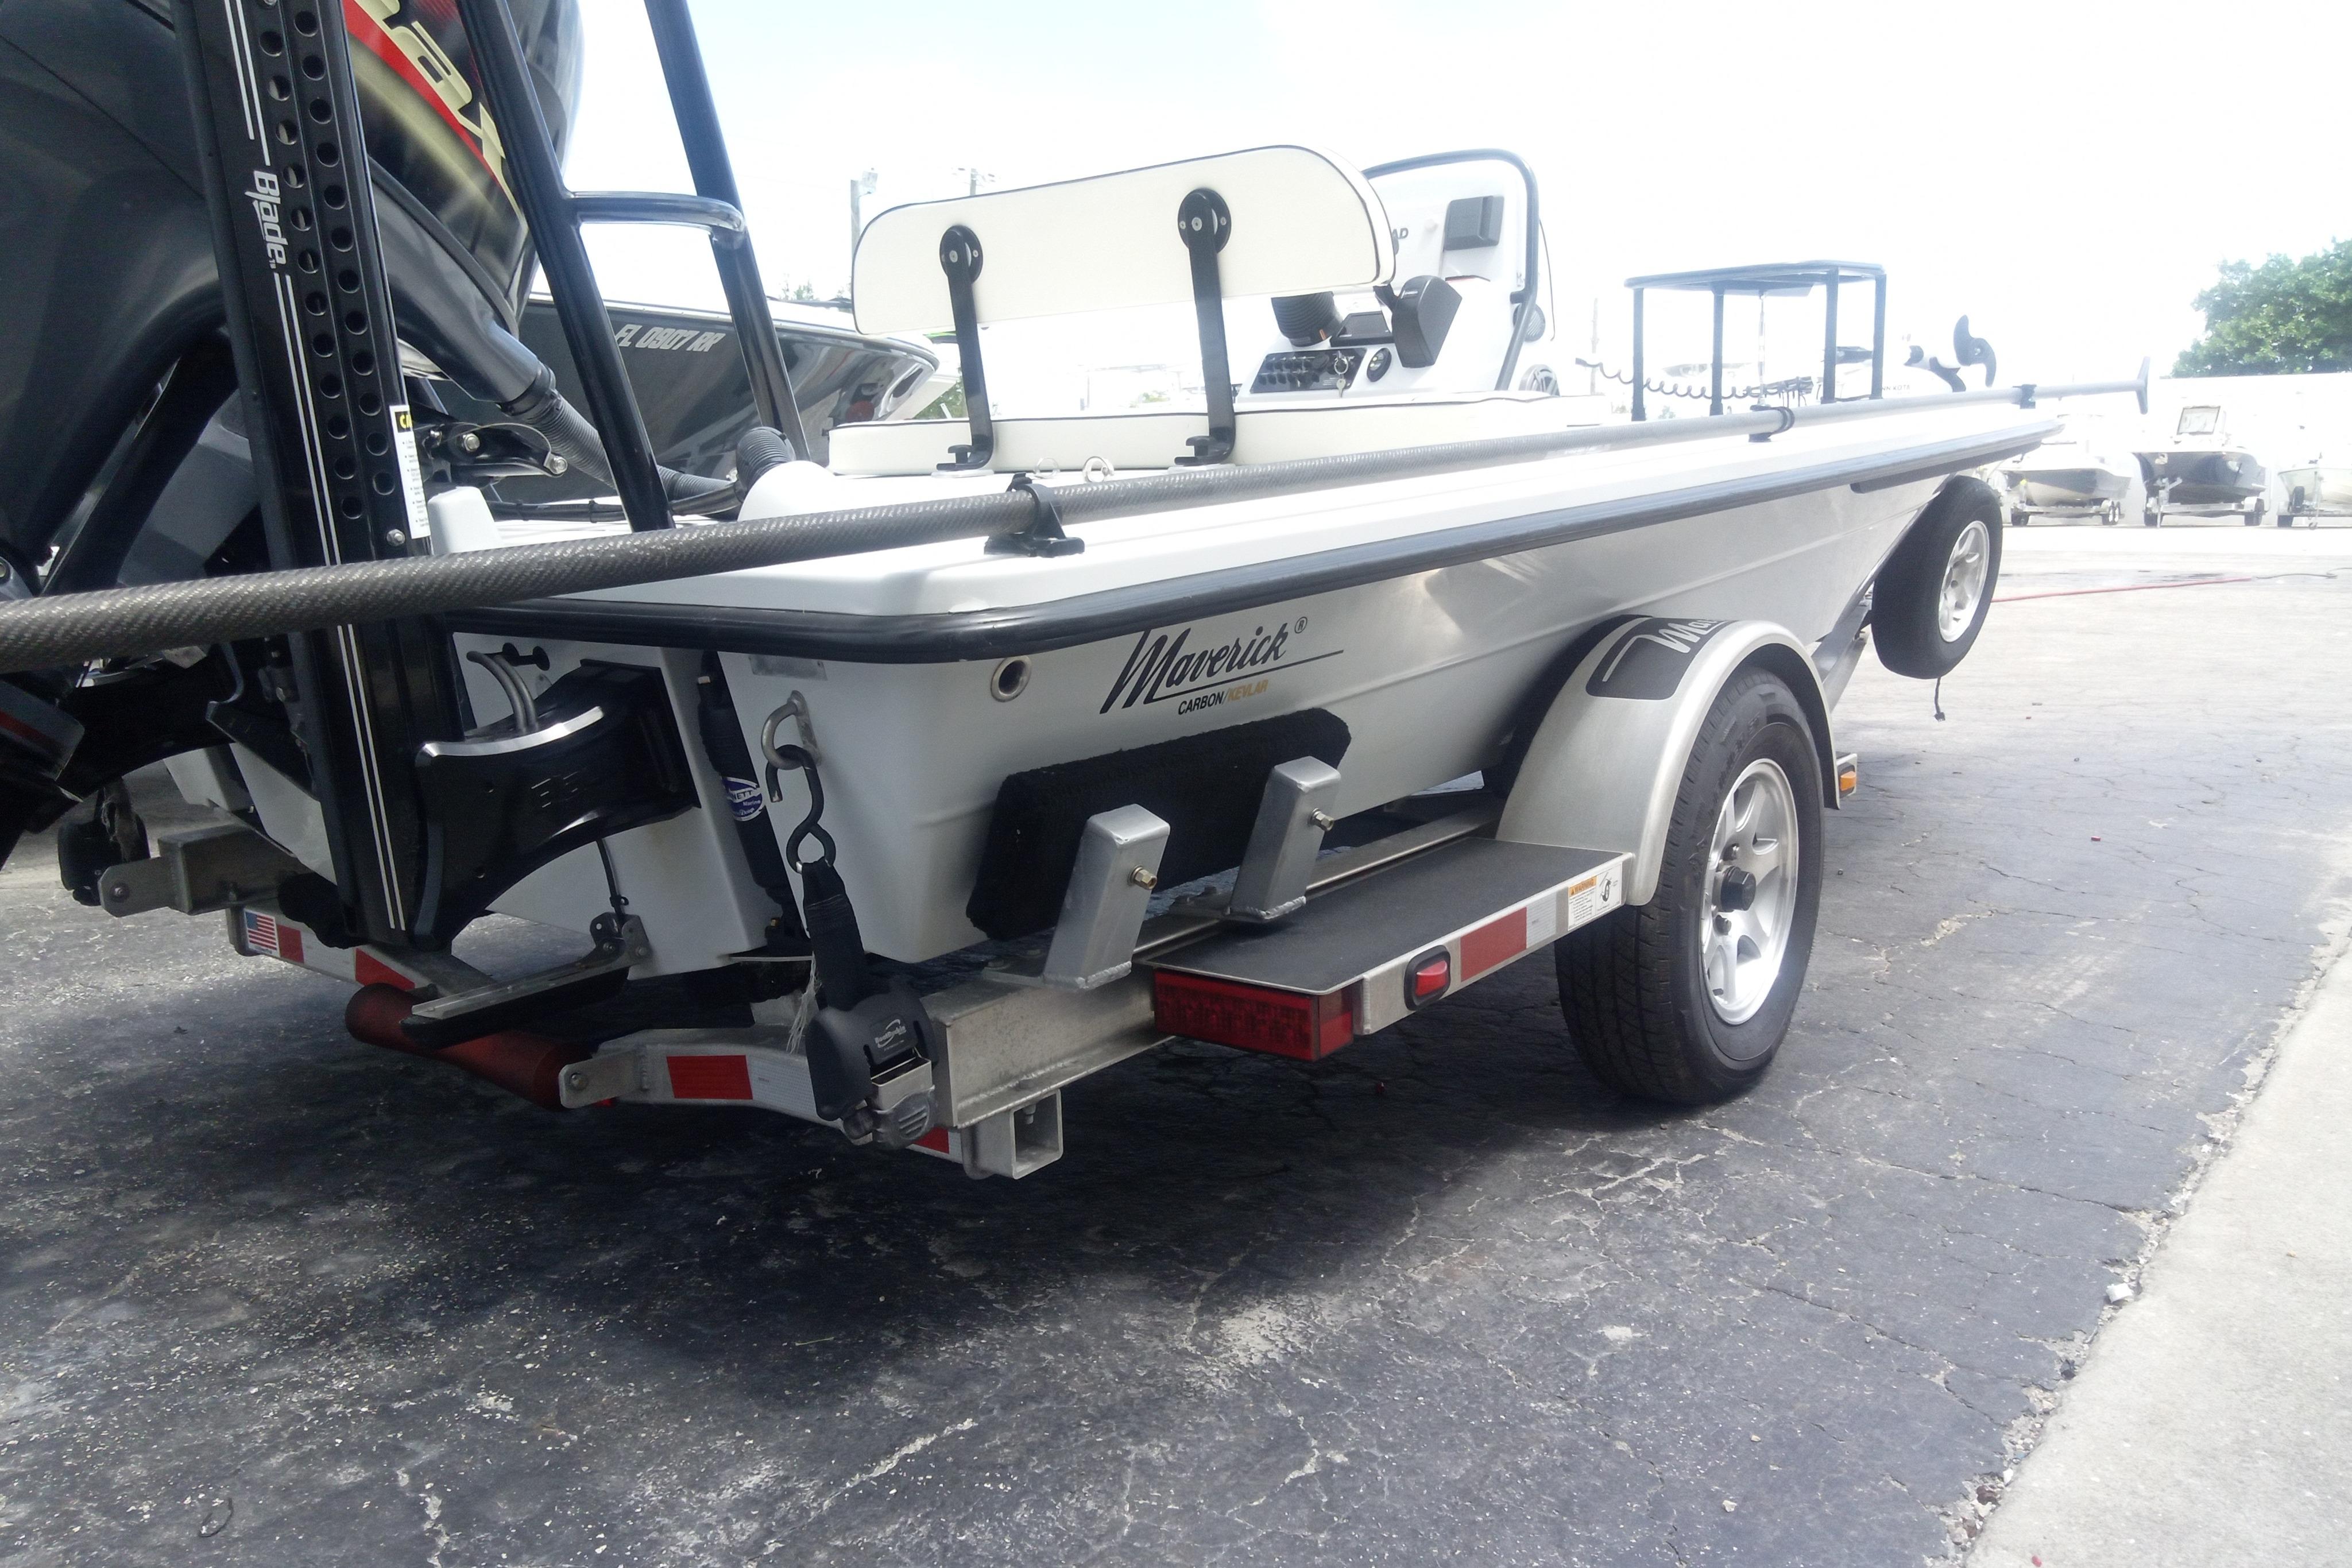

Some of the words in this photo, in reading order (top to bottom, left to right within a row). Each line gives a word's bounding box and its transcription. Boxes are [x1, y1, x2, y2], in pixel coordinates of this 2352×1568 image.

[616, 324, 643, 347] FL
[635, 327, 700, 350] 0907
[1099, 622, 1290, 715] Maverick
[1574, 878, 1595, 893] WARNING
